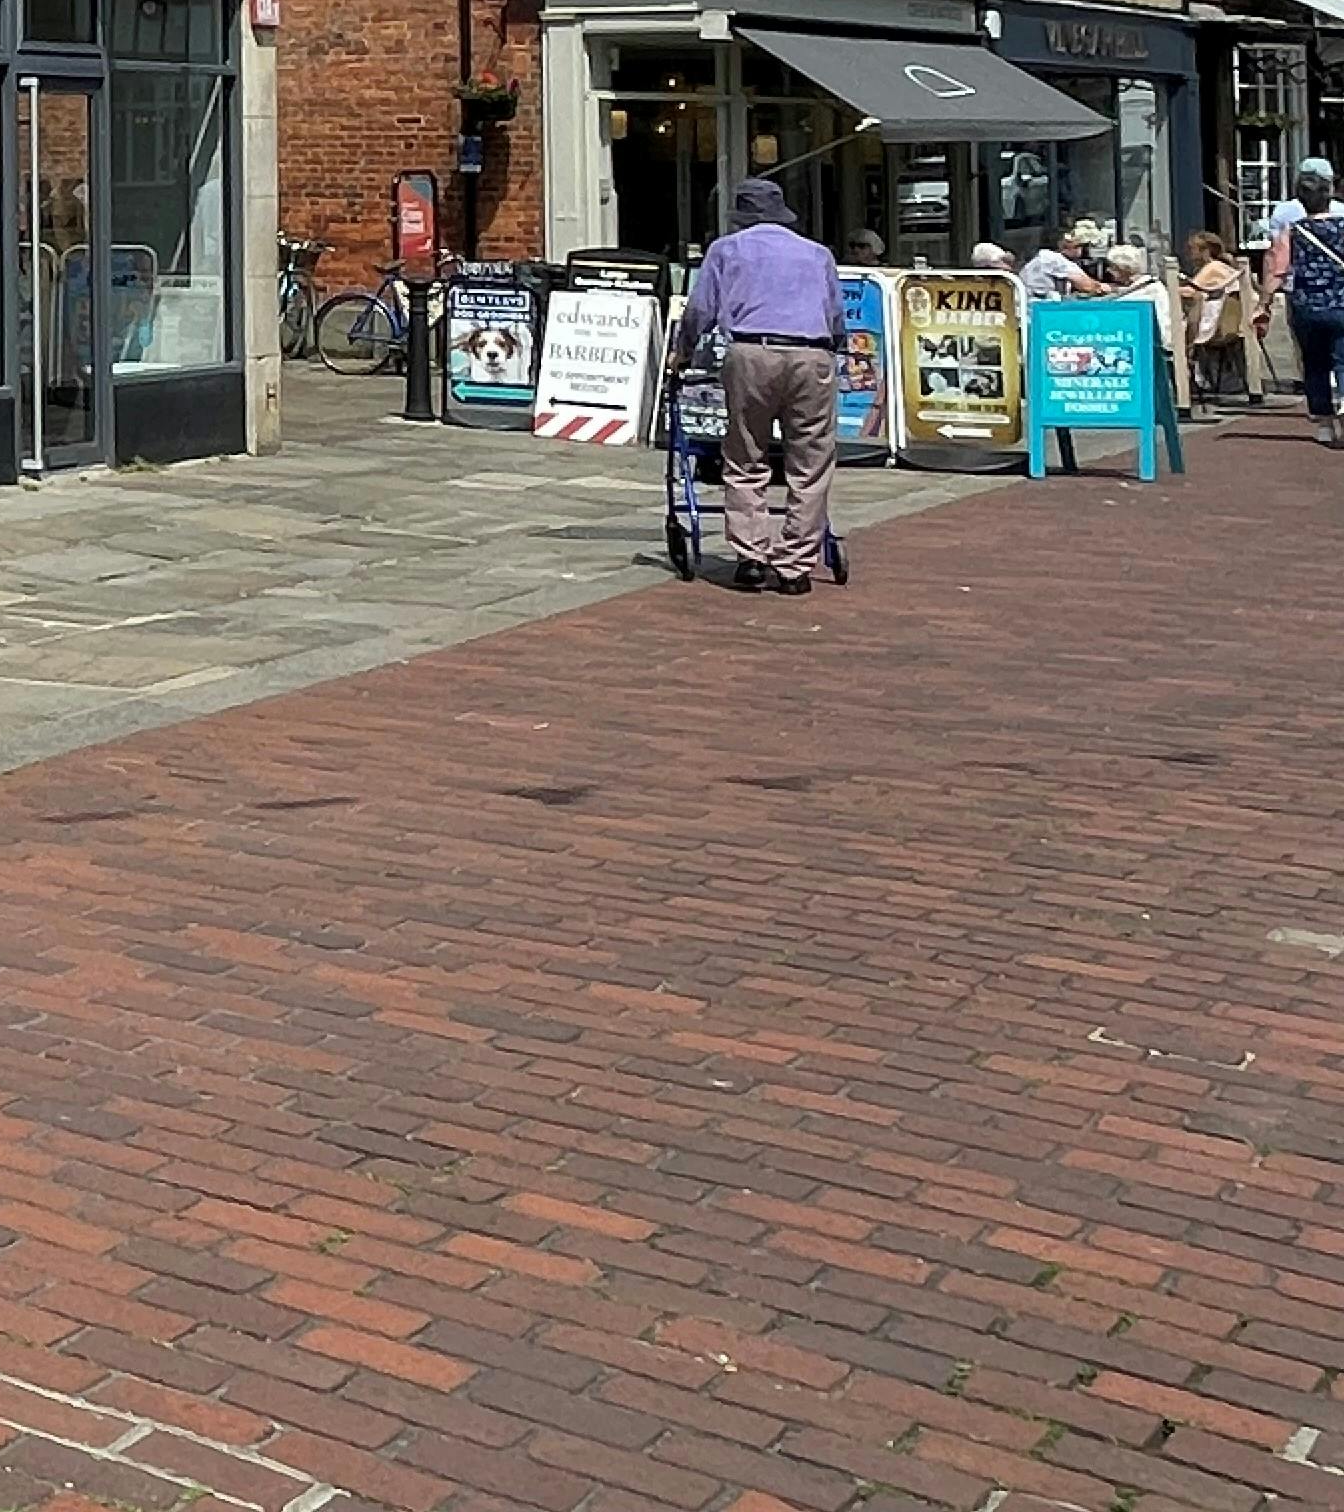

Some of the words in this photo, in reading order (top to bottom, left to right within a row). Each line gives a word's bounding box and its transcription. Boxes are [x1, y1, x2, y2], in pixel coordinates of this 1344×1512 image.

[935, 290, 1002, 311] KING
[556, 300, 640, 328] edwards
[936, 311, 1007, 326] BARBER
[1046, 330, 1133, 344] Crystals
[549, 343, 638, 366] BARBERS
